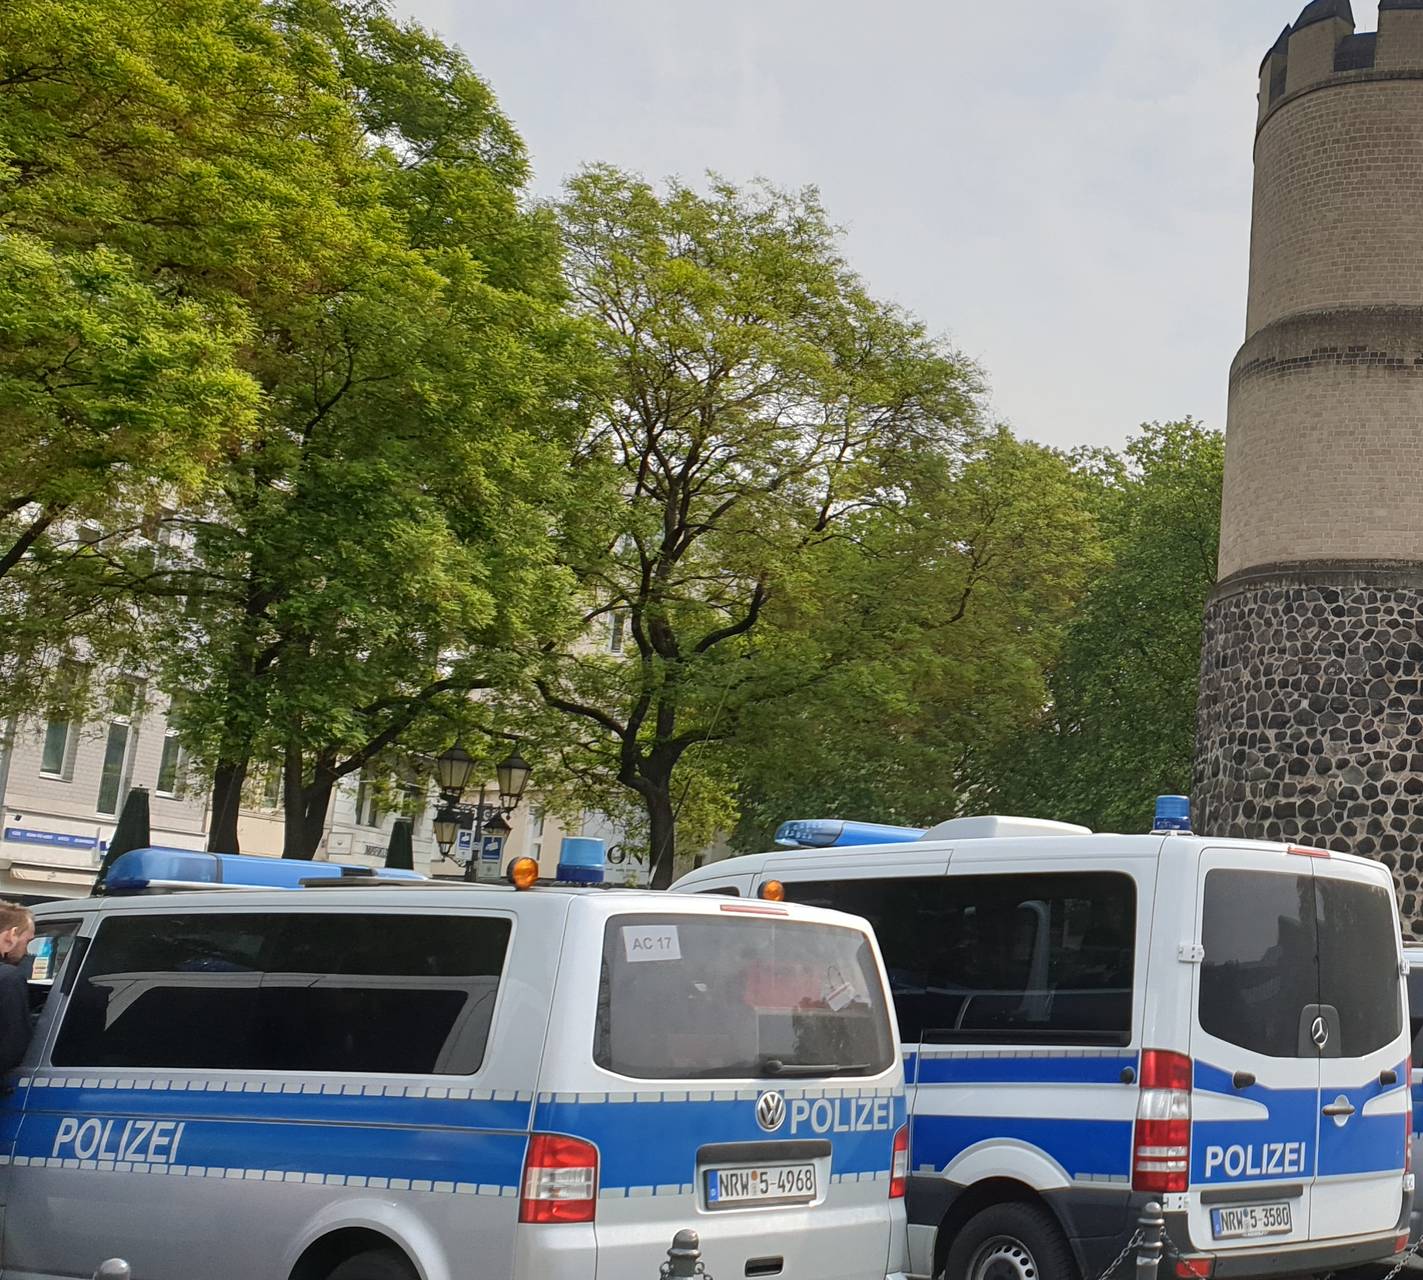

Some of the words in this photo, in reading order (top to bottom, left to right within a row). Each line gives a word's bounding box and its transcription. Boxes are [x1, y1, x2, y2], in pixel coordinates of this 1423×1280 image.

[632, 937, 654, 950] AC
[657, 937, 673, 950] 17
[790, 1097, 894, 1135] POLIZEI
[51, 1117, 186, 1164] POLIZEI
[1205, 1141, 1306, 1178] POLIZEI
[719, 1172, 749, 1198] NRW
[760, 1168, 813, 1194] 5-4968
[1221, 1210, 1244, 1231] NRW
[1250, 1206, 1290, 1228] 5-3580
